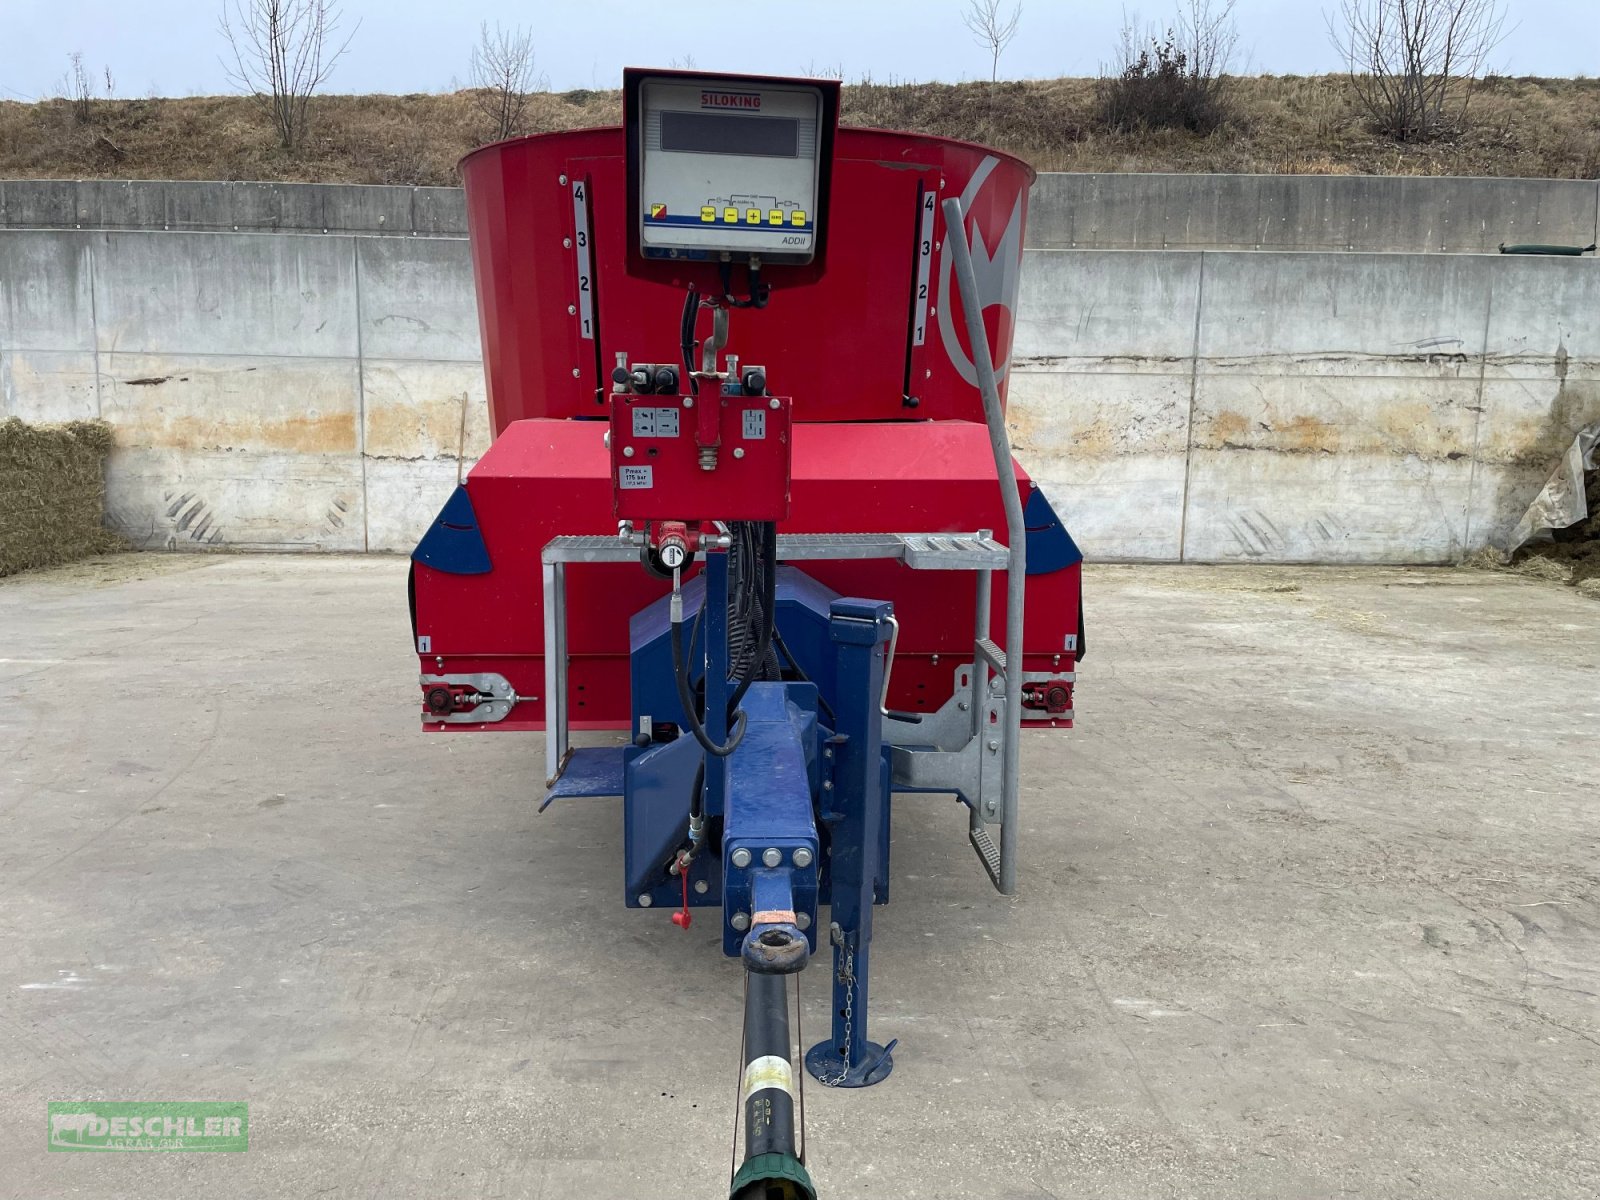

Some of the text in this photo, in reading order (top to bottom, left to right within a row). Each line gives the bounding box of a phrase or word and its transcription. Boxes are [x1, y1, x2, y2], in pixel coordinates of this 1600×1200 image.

[701, 94, 761, 108] SILOKING
[575, 186, 583, 201] 4
[924, 195, 934, 211] 4
[578, 231, 586, 247] 3
[921, 240, 930, 256] 3
[580, 276, 589, 291] 2
[918, 284, 927, 299] 2
[583, 319, 590, 334] 1
[917, 326, 923, 341] 1
